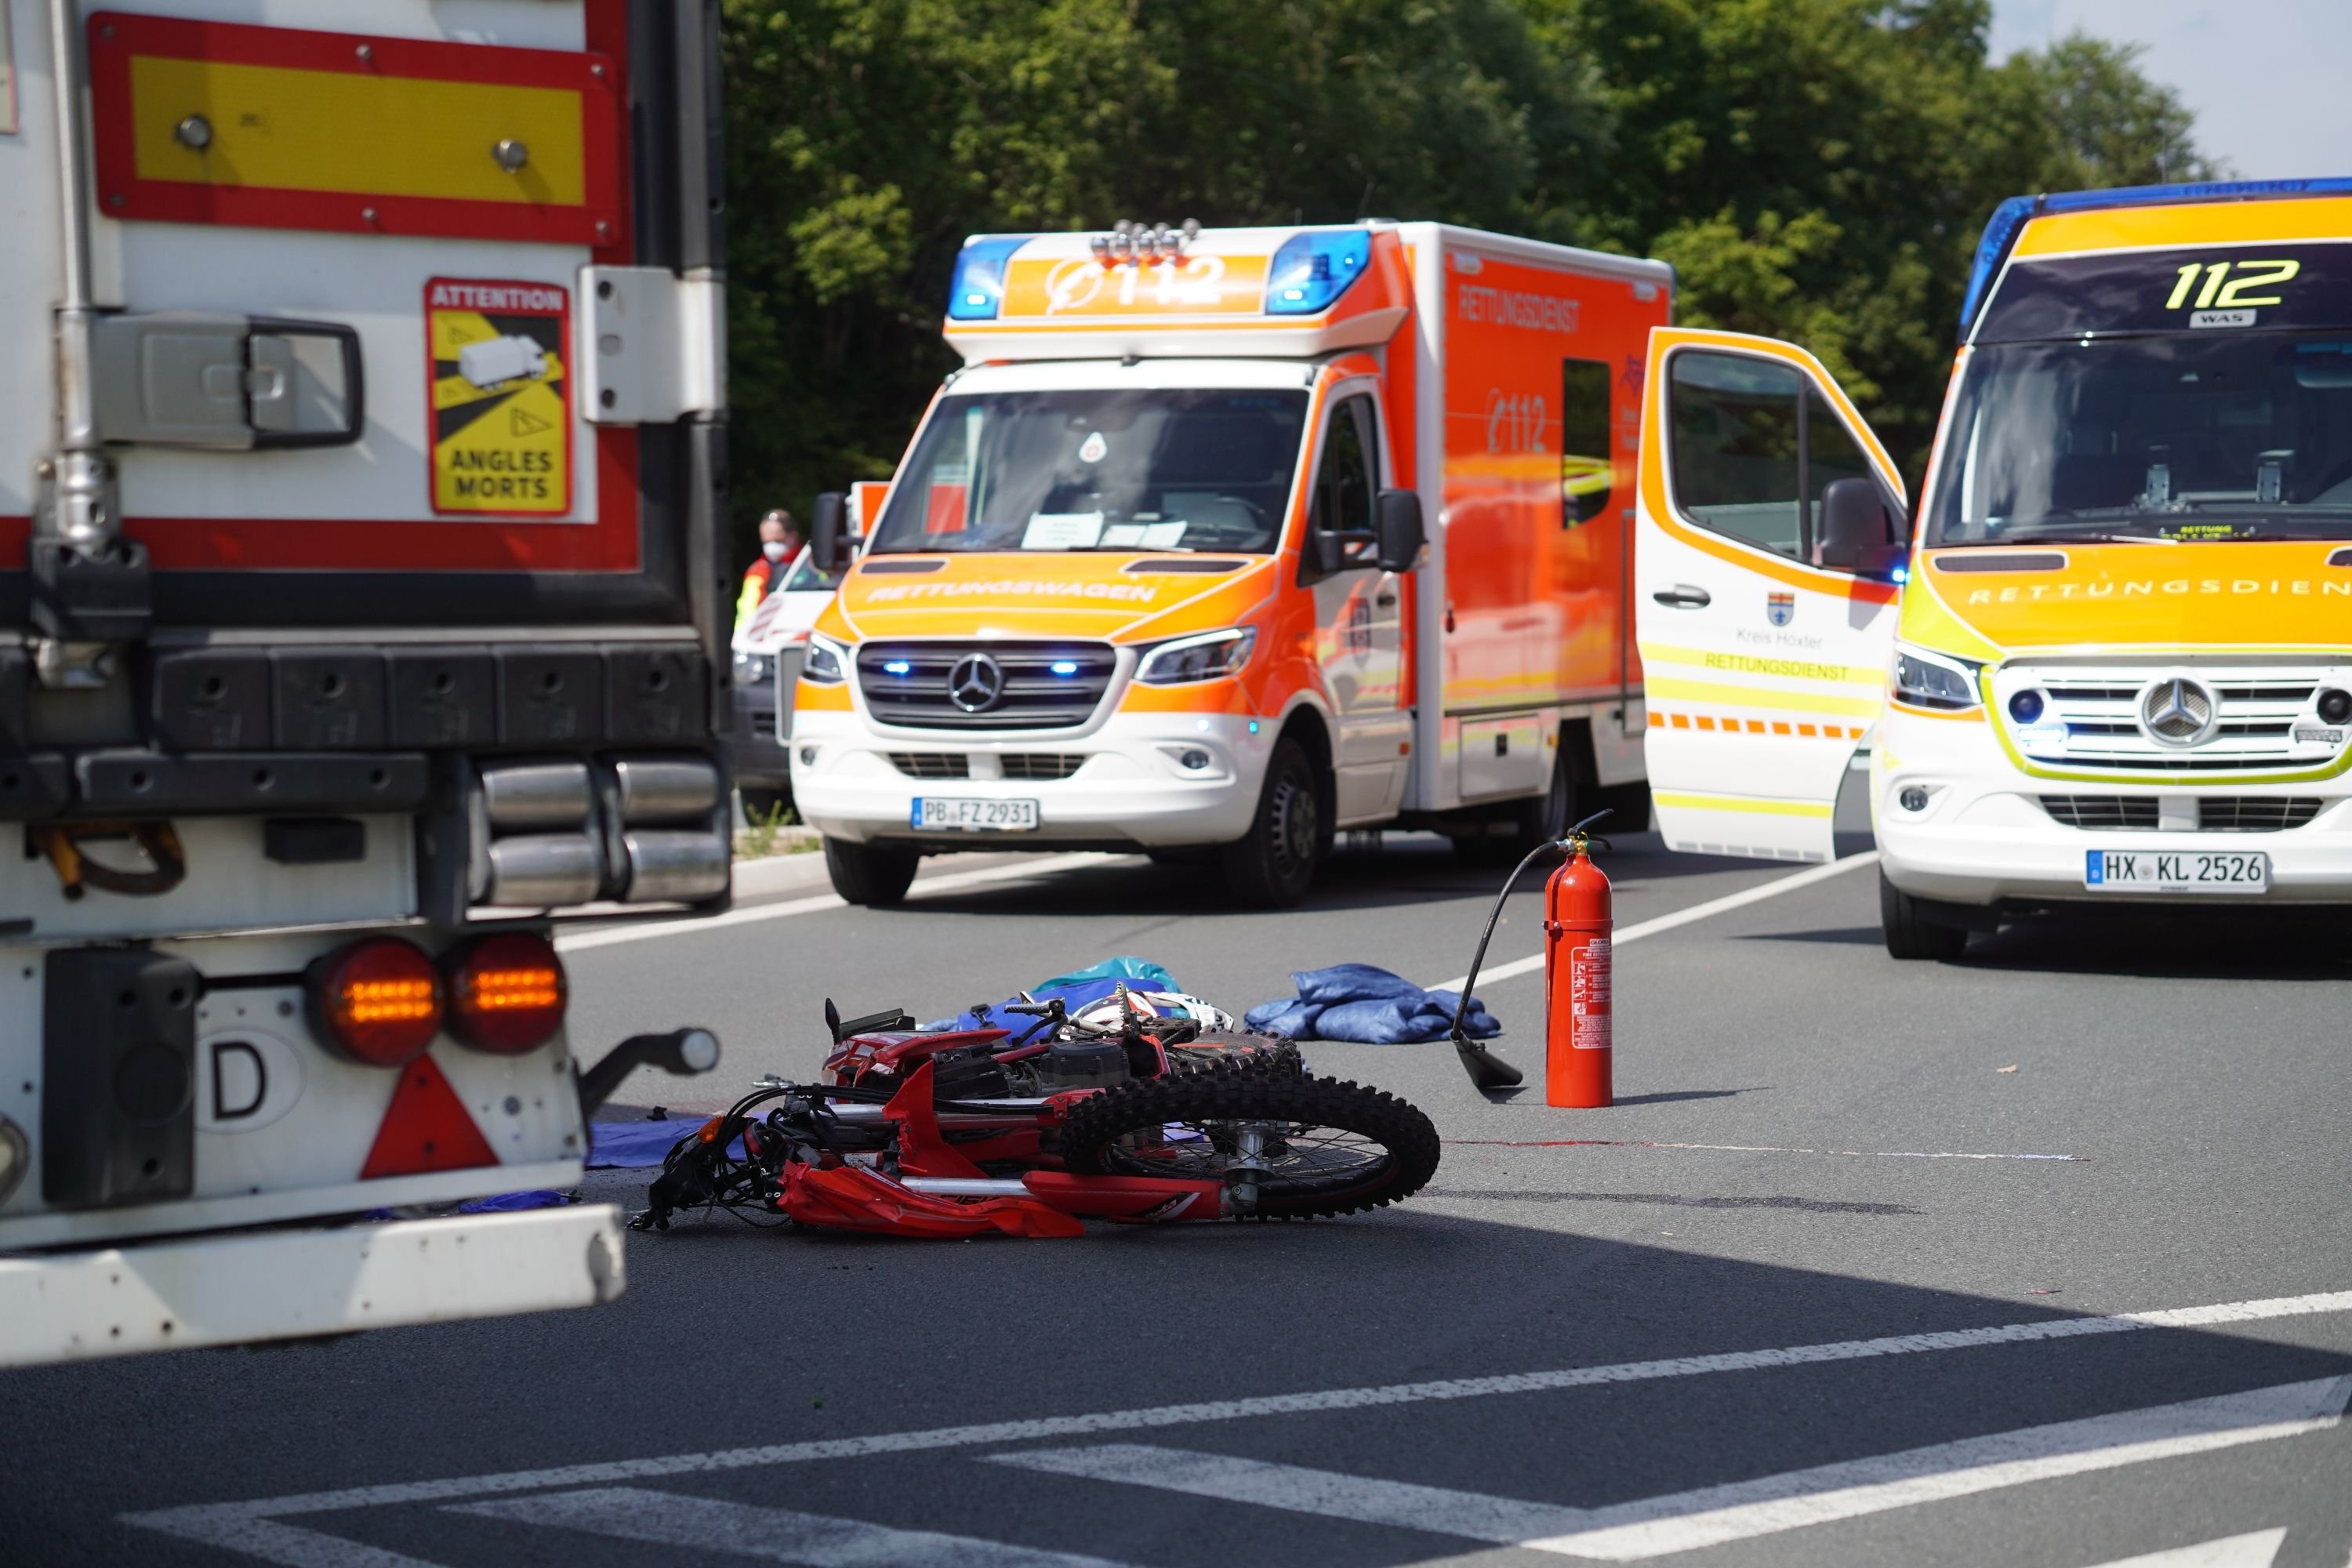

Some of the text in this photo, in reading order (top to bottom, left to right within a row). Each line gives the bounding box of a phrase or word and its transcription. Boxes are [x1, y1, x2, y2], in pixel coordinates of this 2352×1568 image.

[1112, 256, 1225, 305] 112
[2166, 260, 2299, 309] 112
[431, 284, 564, 311] ATTENTION
[1459, 283, 1581, 334] RETTUNGSDIENST
[2201, 314, 2244, 323] WAS
[1507, 392, 1546, 452] 112
[451, 450, 553, 472] ANGLES
[456, 477, 548, 499] MORTS
[866, 580, 1156, 603] RETTUNGSWAGEN
[1968, 579, 2352, 605] RETTUNGSDIEN
[1737, 629, 1772, 644] Kreis
[1705, 652, 1849, 681] RETTUNGSDIENST
[925, 801, 946, 822] PB
[960, 803, 981, 822] FZ
[987, 804, 1031, 823] 2931
[2106, 856, 2261, 881] HX KL 2526
[211, 1040, 267, 1121] D
